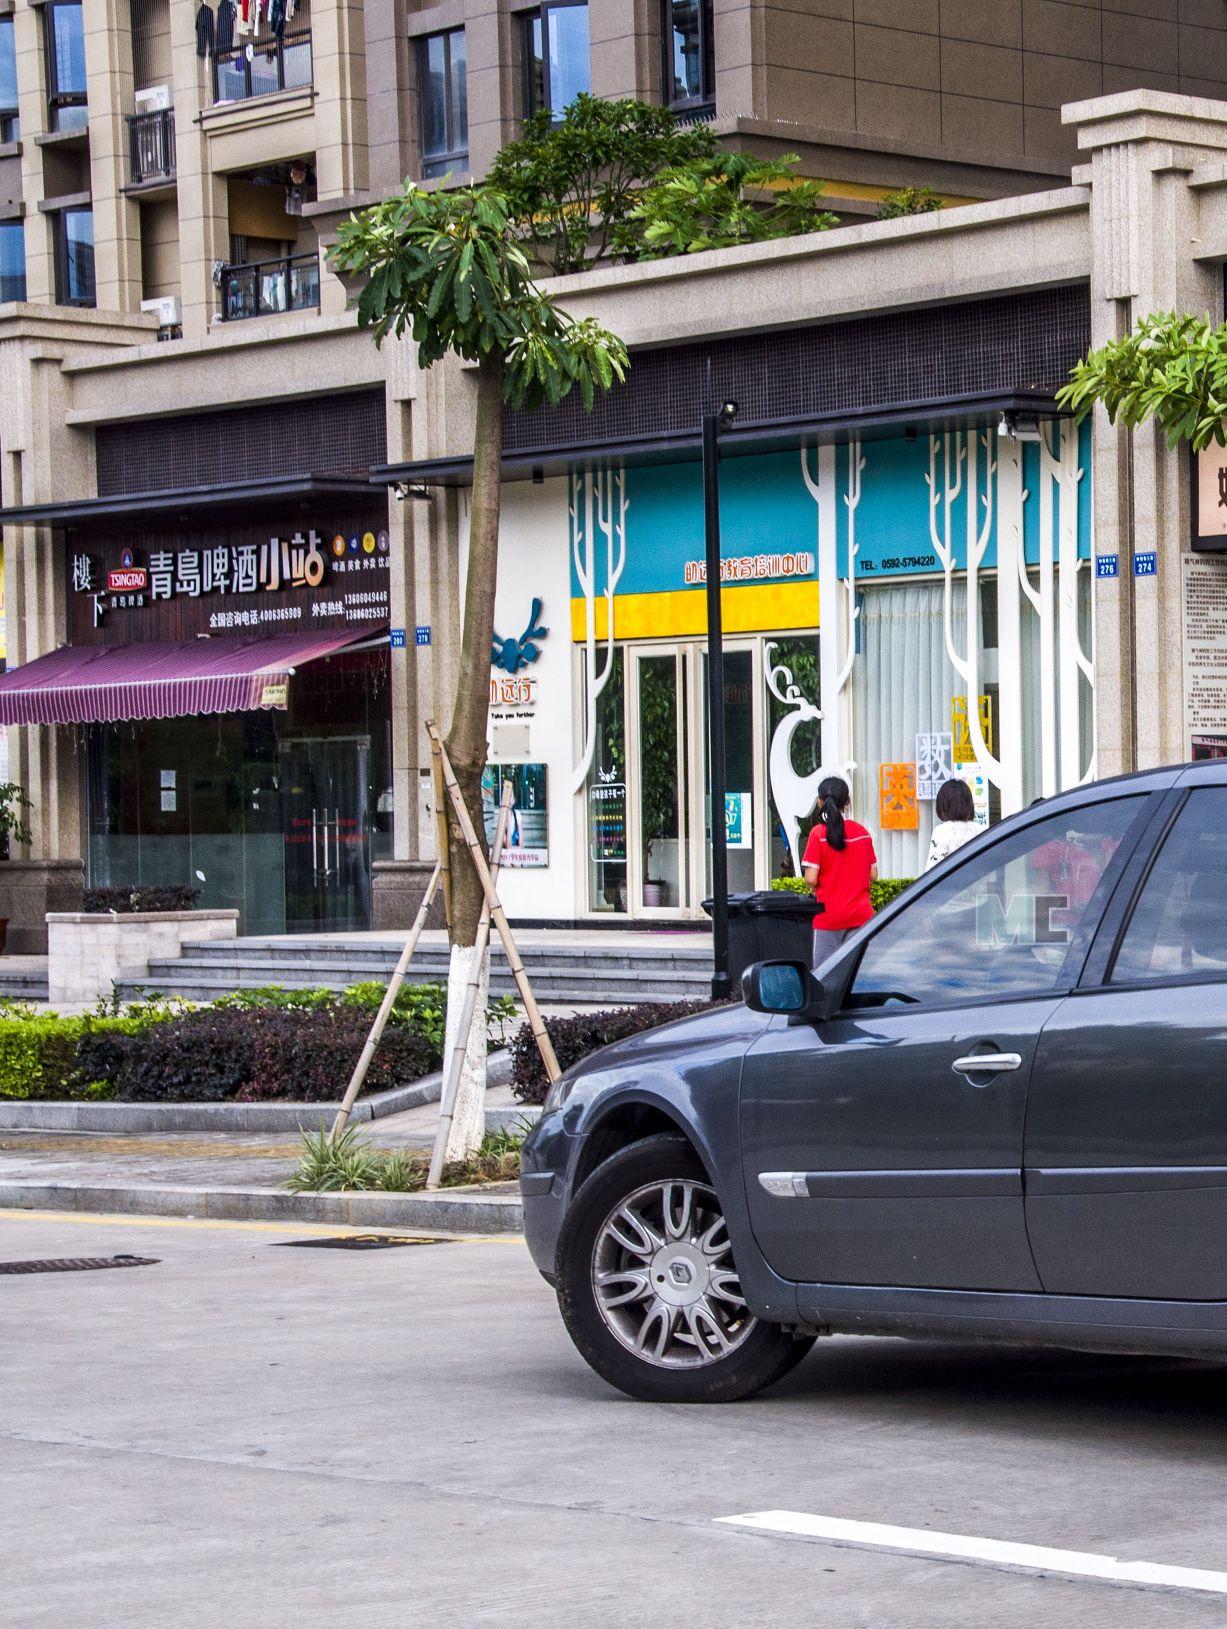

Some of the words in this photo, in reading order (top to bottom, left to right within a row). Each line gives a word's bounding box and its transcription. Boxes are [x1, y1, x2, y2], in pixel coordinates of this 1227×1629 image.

[149, 529, 325, 601] 青岛啤酒小站
[881, 556, 935, 570] 0592-5794220
[1100, 564, 1114, 575] 276
[1137, 562, 1152, 574] 274
[111, 573, 145, 587] TSINGTAO
[918, 735, 951, 781] 数
[881, 765, 915, 813] 英
[976, 894, 1070, 946] ME
